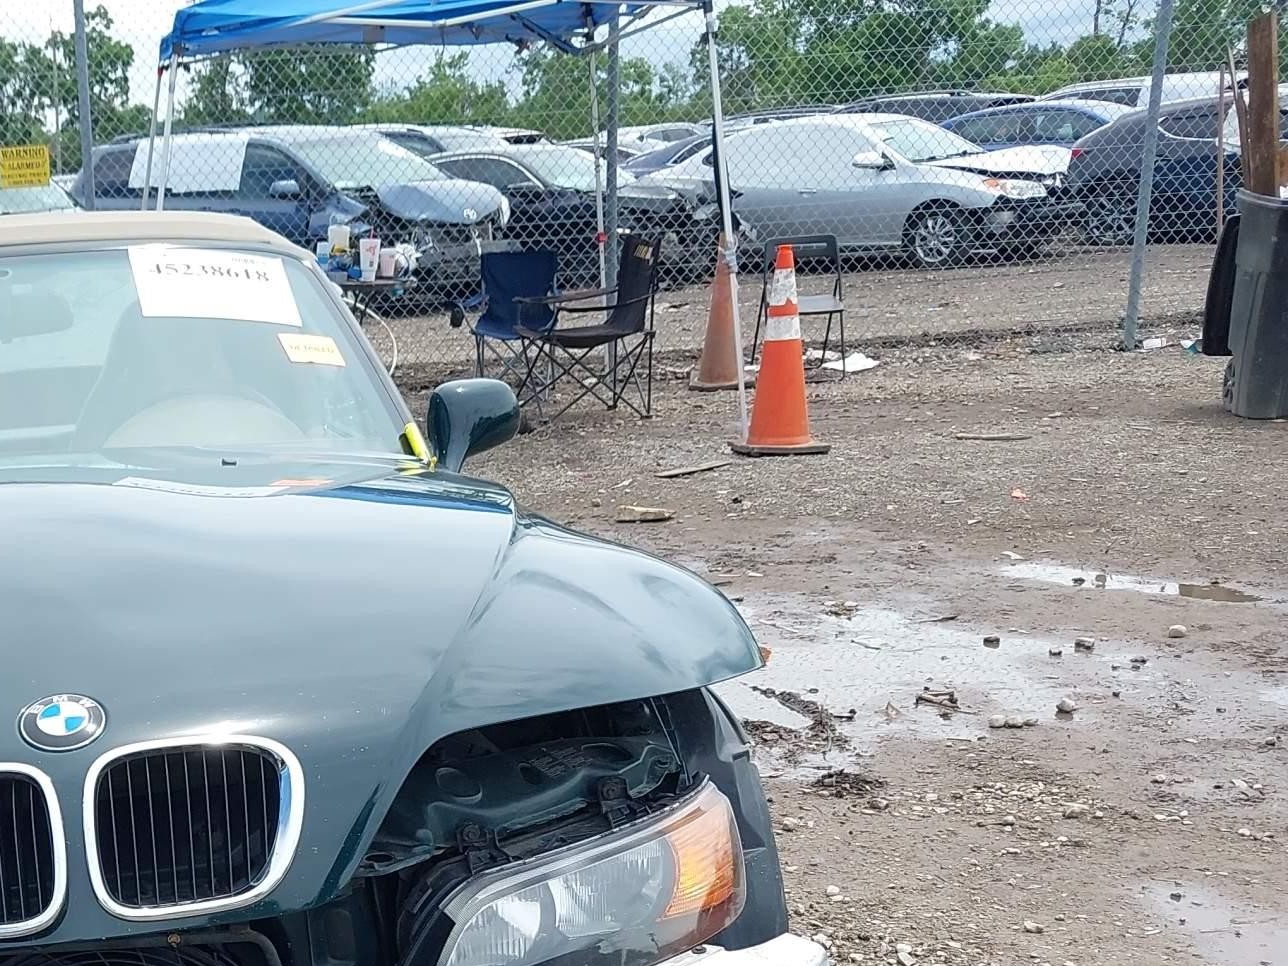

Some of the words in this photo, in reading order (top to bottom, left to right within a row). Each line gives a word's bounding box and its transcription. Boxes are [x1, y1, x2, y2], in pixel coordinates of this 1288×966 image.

[0, 147, 45, 159] WARNING
[149, 263, 270, 282] 45238618
[29, 695, 97, 714] BMW
